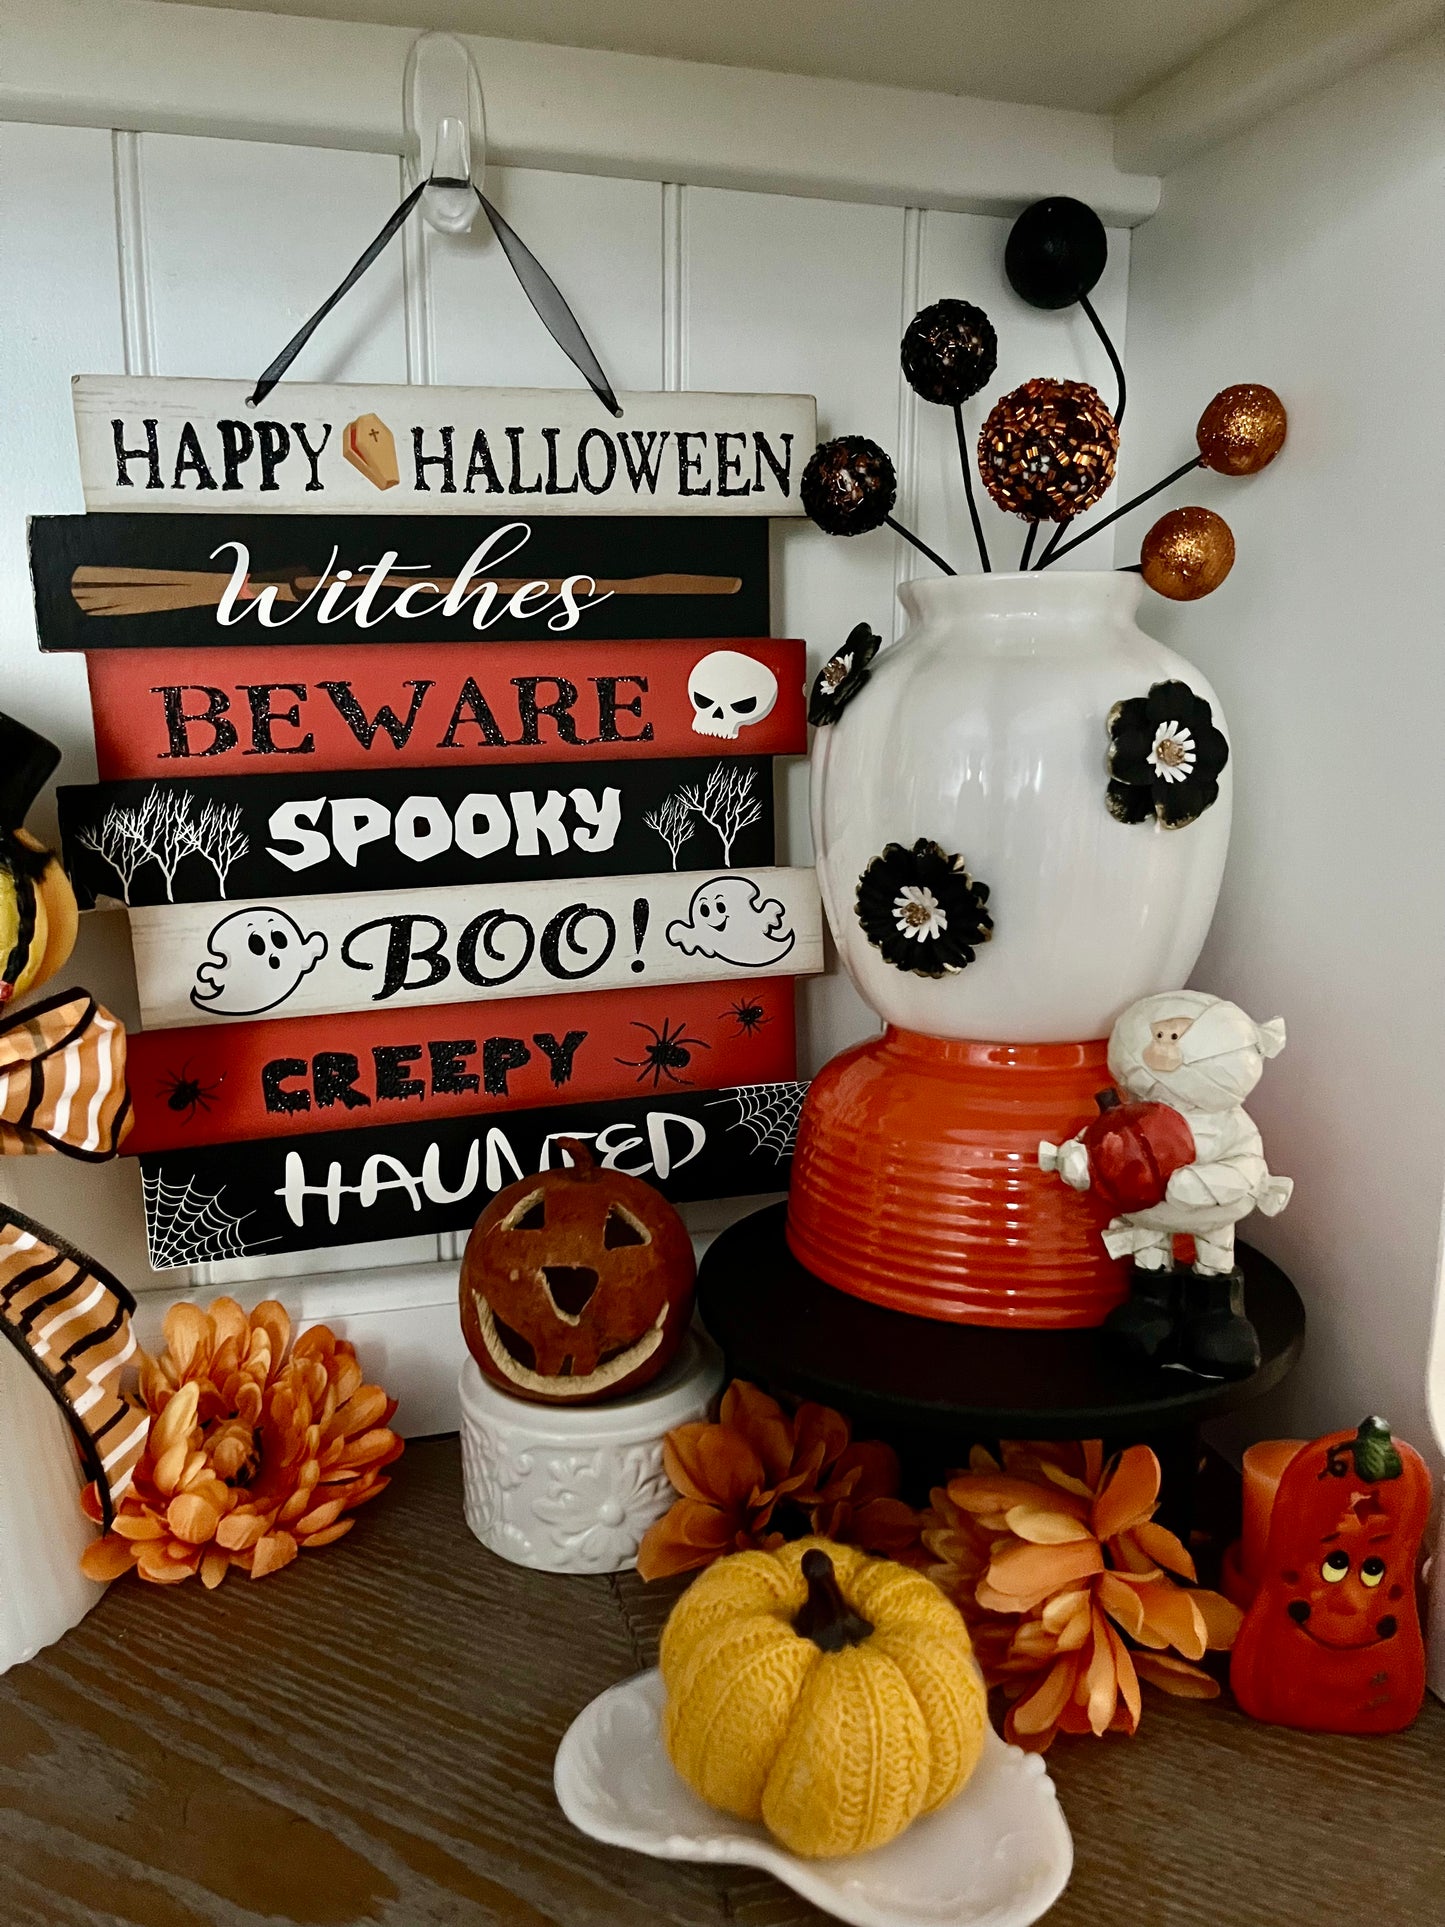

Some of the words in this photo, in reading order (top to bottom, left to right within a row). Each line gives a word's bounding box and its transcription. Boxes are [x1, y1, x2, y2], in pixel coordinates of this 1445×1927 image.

[112, 419, 331, 491] HAPPY
[414, 427, 795, 498] HALLOWEEN
[210, 523, 613, 631] Witches
[151, 676, 654, 758] BEWARE
[266, 787, 621, 871] SPOOKY
[341, 898, 649, 1000] BOO!
[262, 1031, 587, 1114] CREEPY
